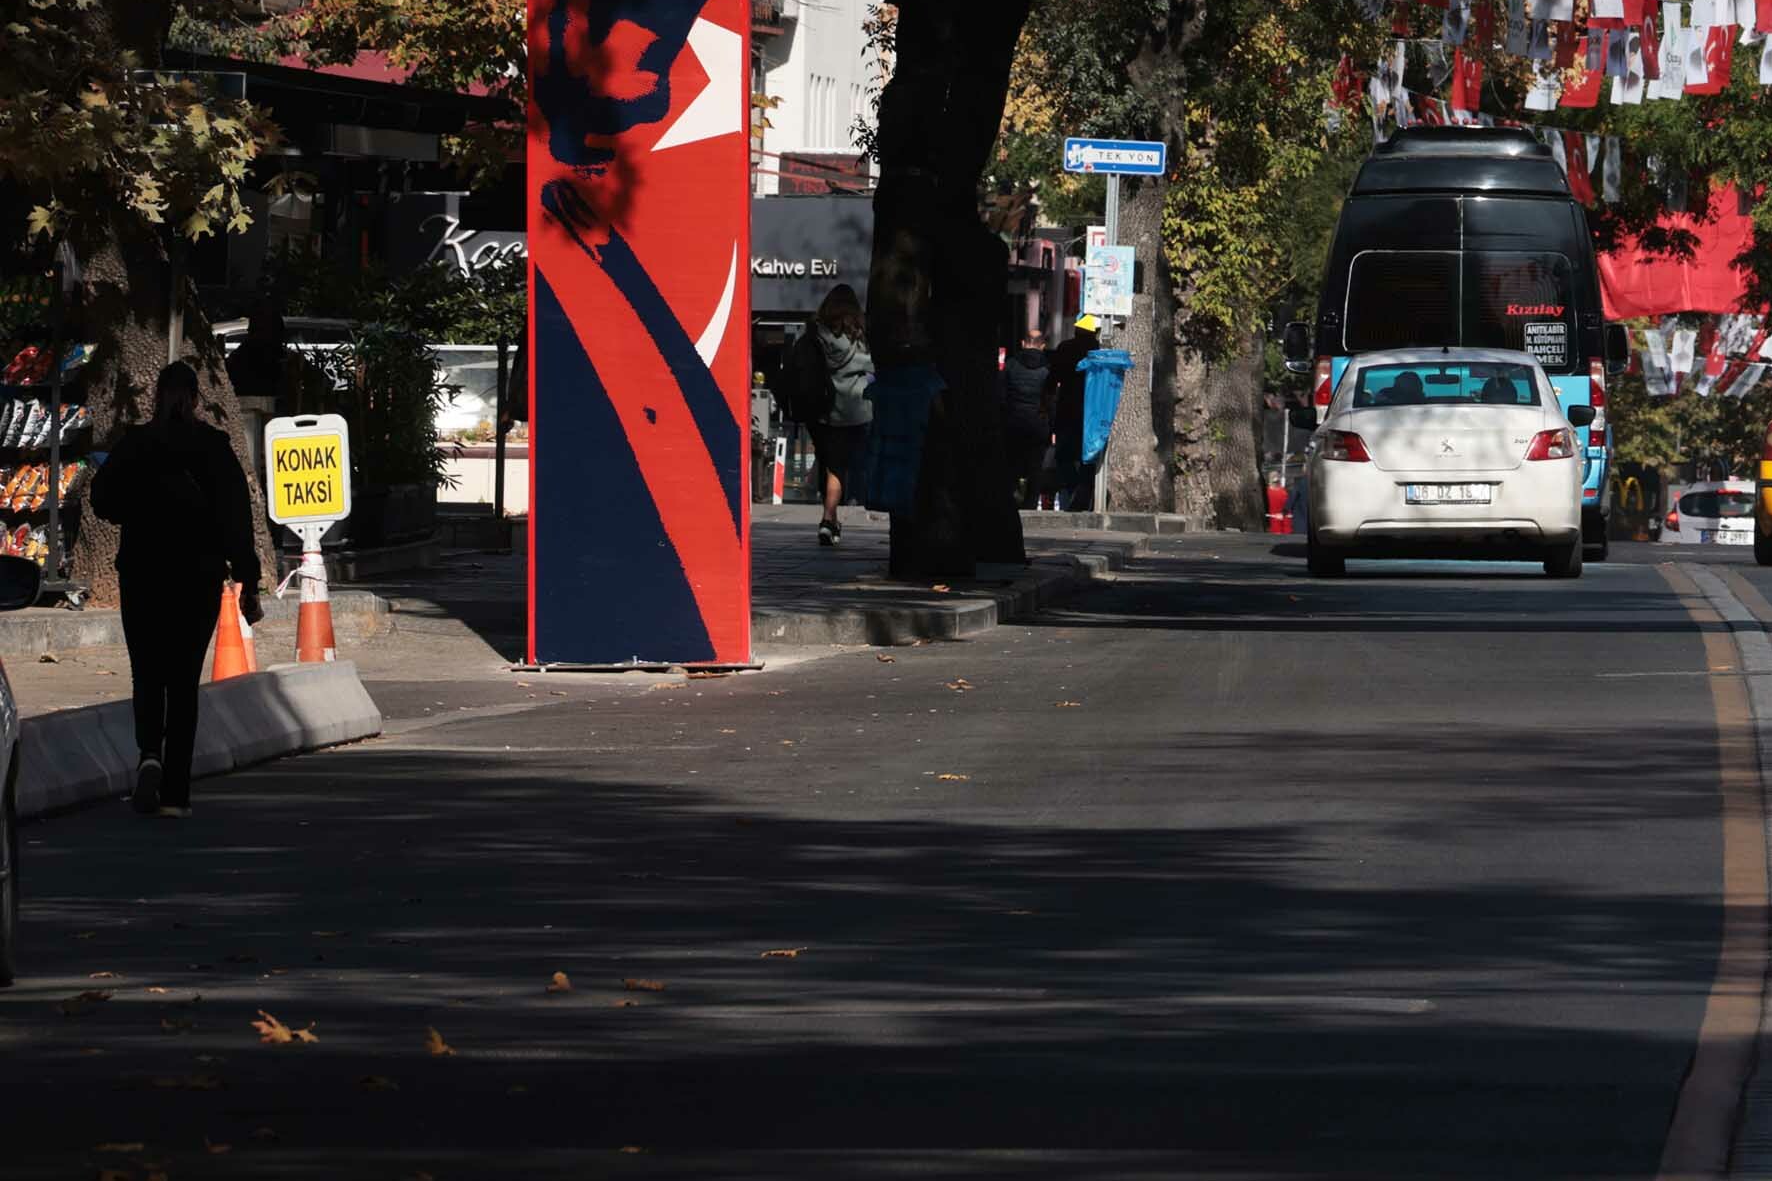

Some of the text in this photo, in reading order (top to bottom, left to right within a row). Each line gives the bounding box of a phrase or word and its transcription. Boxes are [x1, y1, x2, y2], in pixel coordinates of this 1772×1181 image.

[750, 258, 837, 276] Kahve Evi
[276, 446, 337, 473] KONAK
[283, 474, 332, 506] TAKSİ
